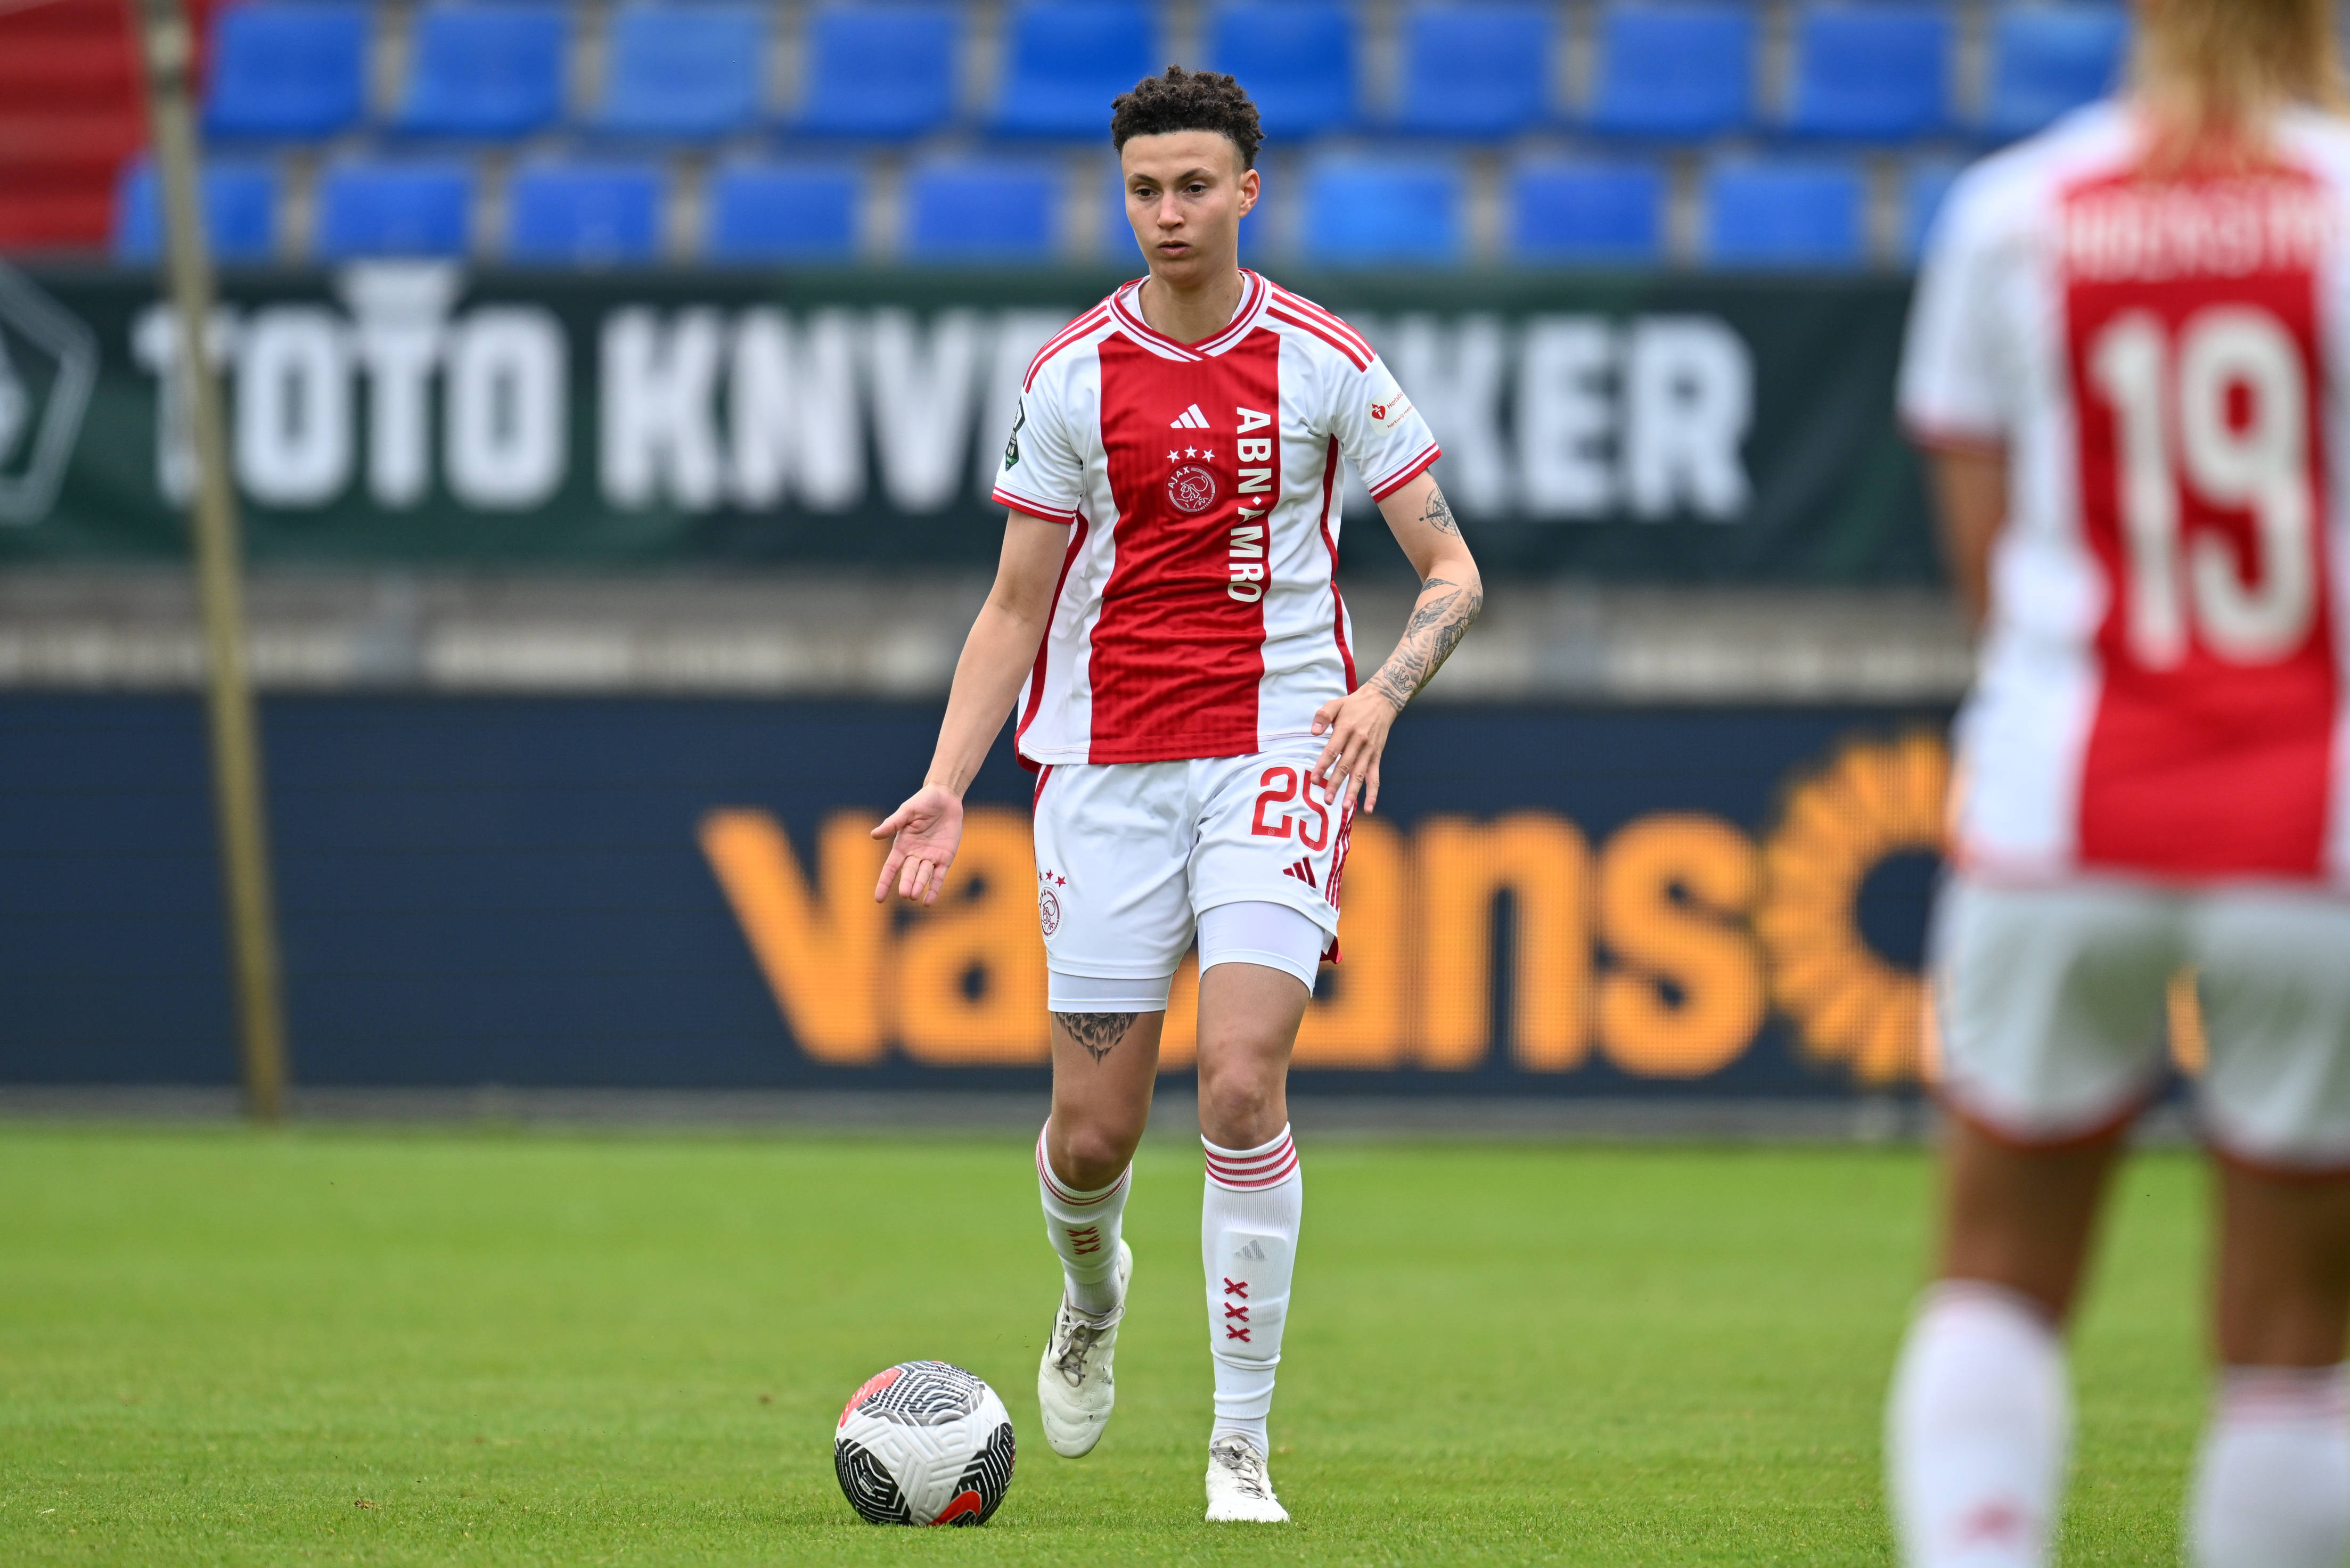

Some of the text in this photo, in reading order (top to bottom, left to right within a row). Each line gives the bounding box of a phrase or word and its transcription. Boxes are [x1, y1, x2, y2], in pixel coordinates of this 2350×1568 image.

[132, 277, 571, 511] TOTO
[1339, 310, 1758, 518] KER
[1168, 466, 1190, 489] AJAX
[1227, 407, 1272, 603] ABN AMRO
[2083, 302, 2316, 668] 19
[1251, 766, 1330, 852] 25
[697, 805, 1762, 1077] vaans
